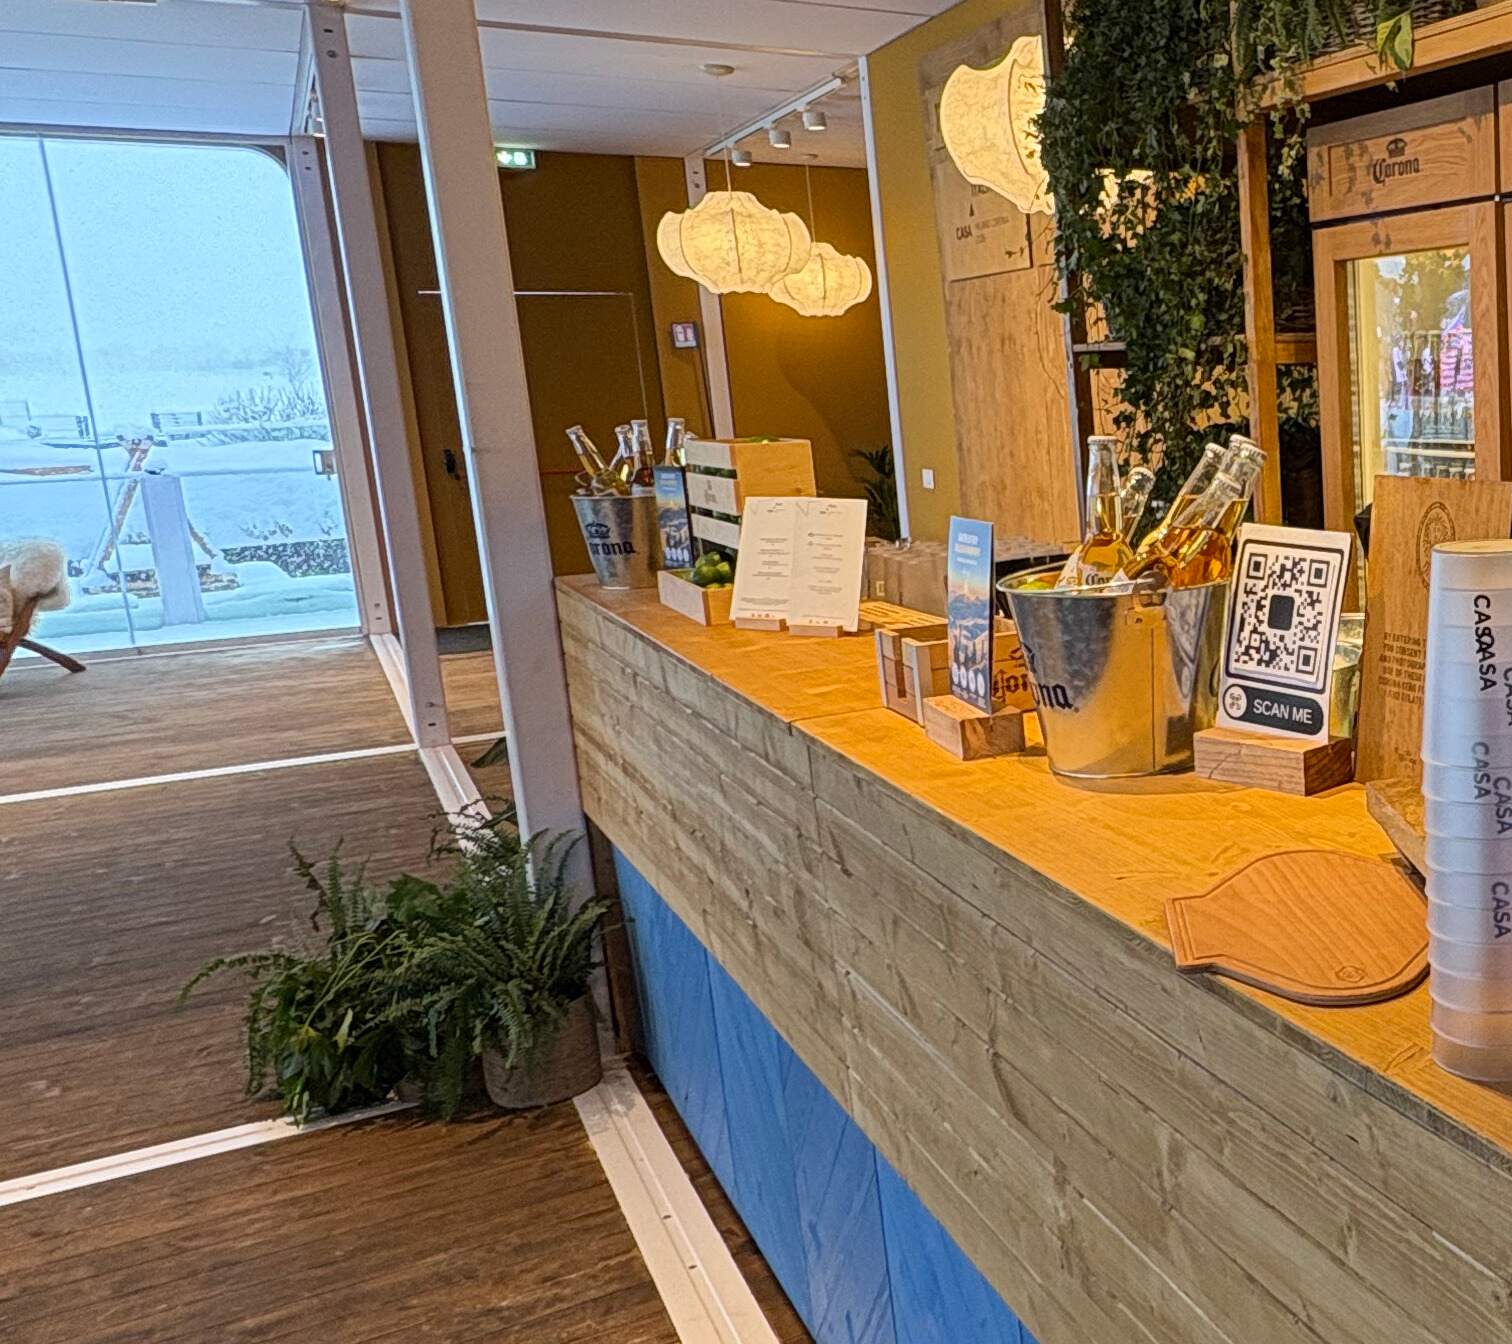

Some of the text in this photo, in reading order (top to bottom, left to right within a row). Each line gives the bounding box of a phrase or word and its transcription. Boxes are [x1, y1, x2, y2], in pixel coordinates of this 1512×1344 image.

[1372, 157, 1420, 185] Corona
[588, 541, 636, 556] orona
[1253, 698, 1312, 724] SCAN ME
[1471, 742, 1491, 800] CASA
[1491, 881, 1512, 939] CASA
